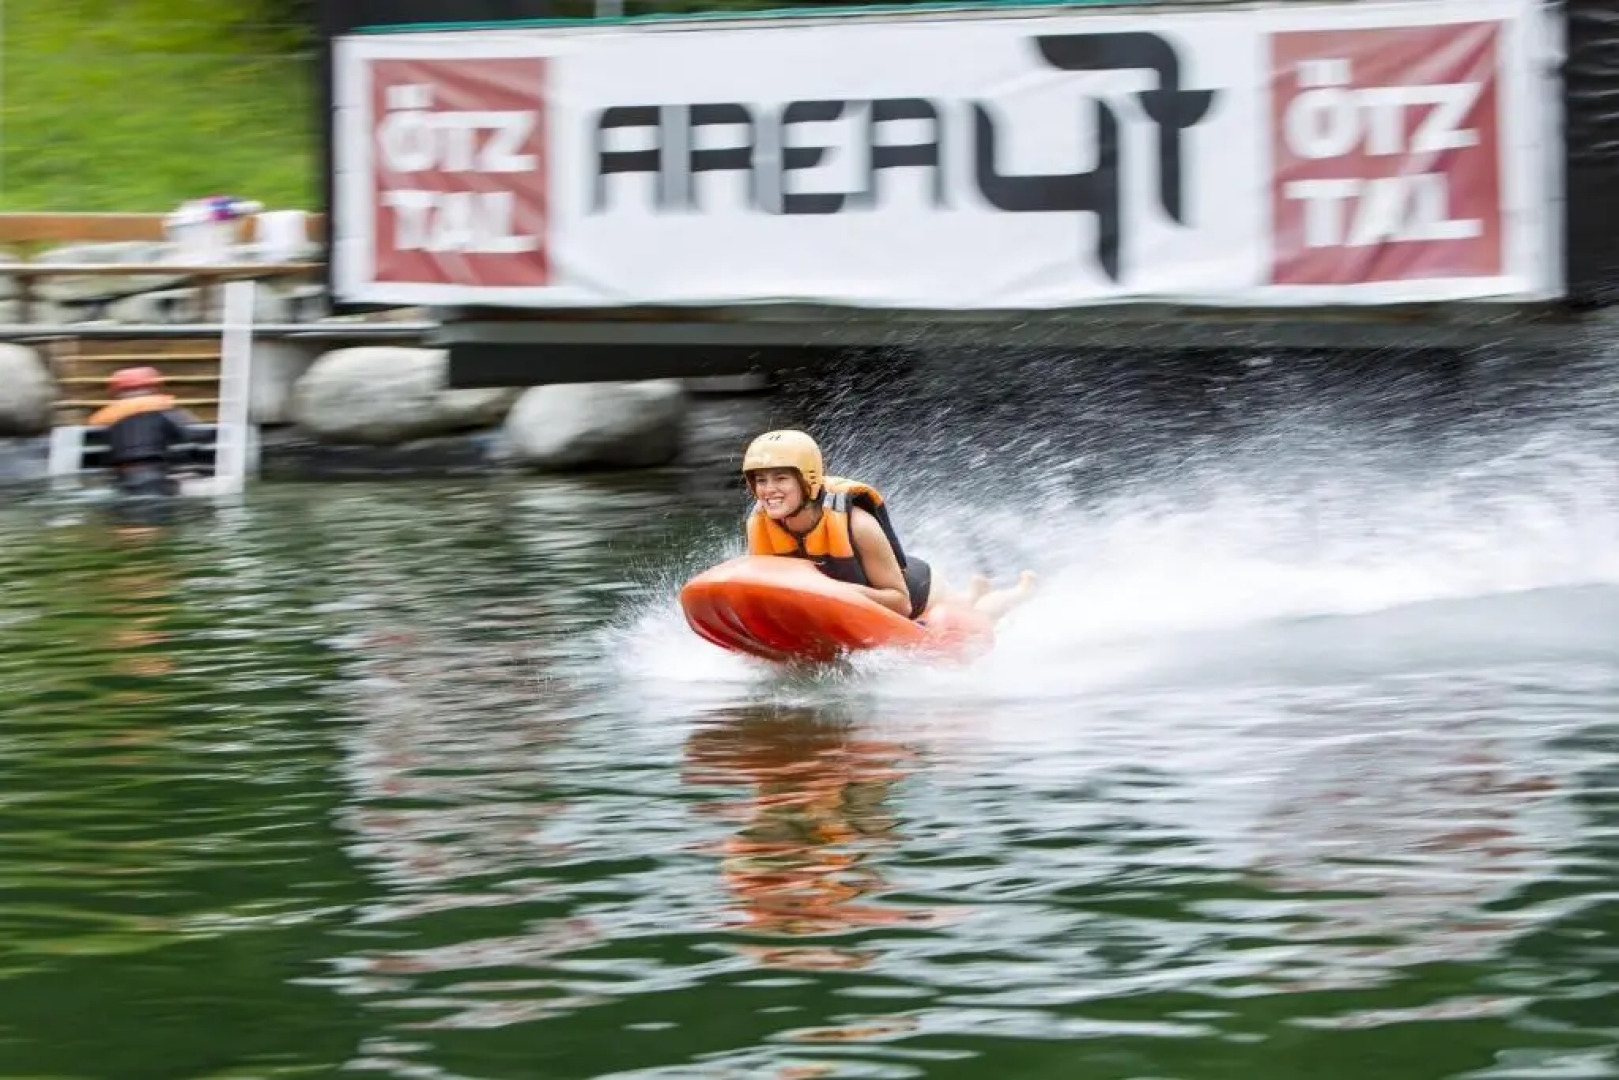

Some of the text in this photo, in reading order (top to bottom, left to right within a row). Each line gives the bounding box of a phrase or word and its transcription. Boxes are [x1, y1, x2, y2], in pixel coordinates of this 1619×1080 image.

[377, 83, 539, 173] ÖTZ
[1284, 57, 1482, 159] ÖTZ
[588, 98, 948, 215] AREA
[381, 189, 539, 253] TAL
[1284, 172, 1483, 248] TAL
